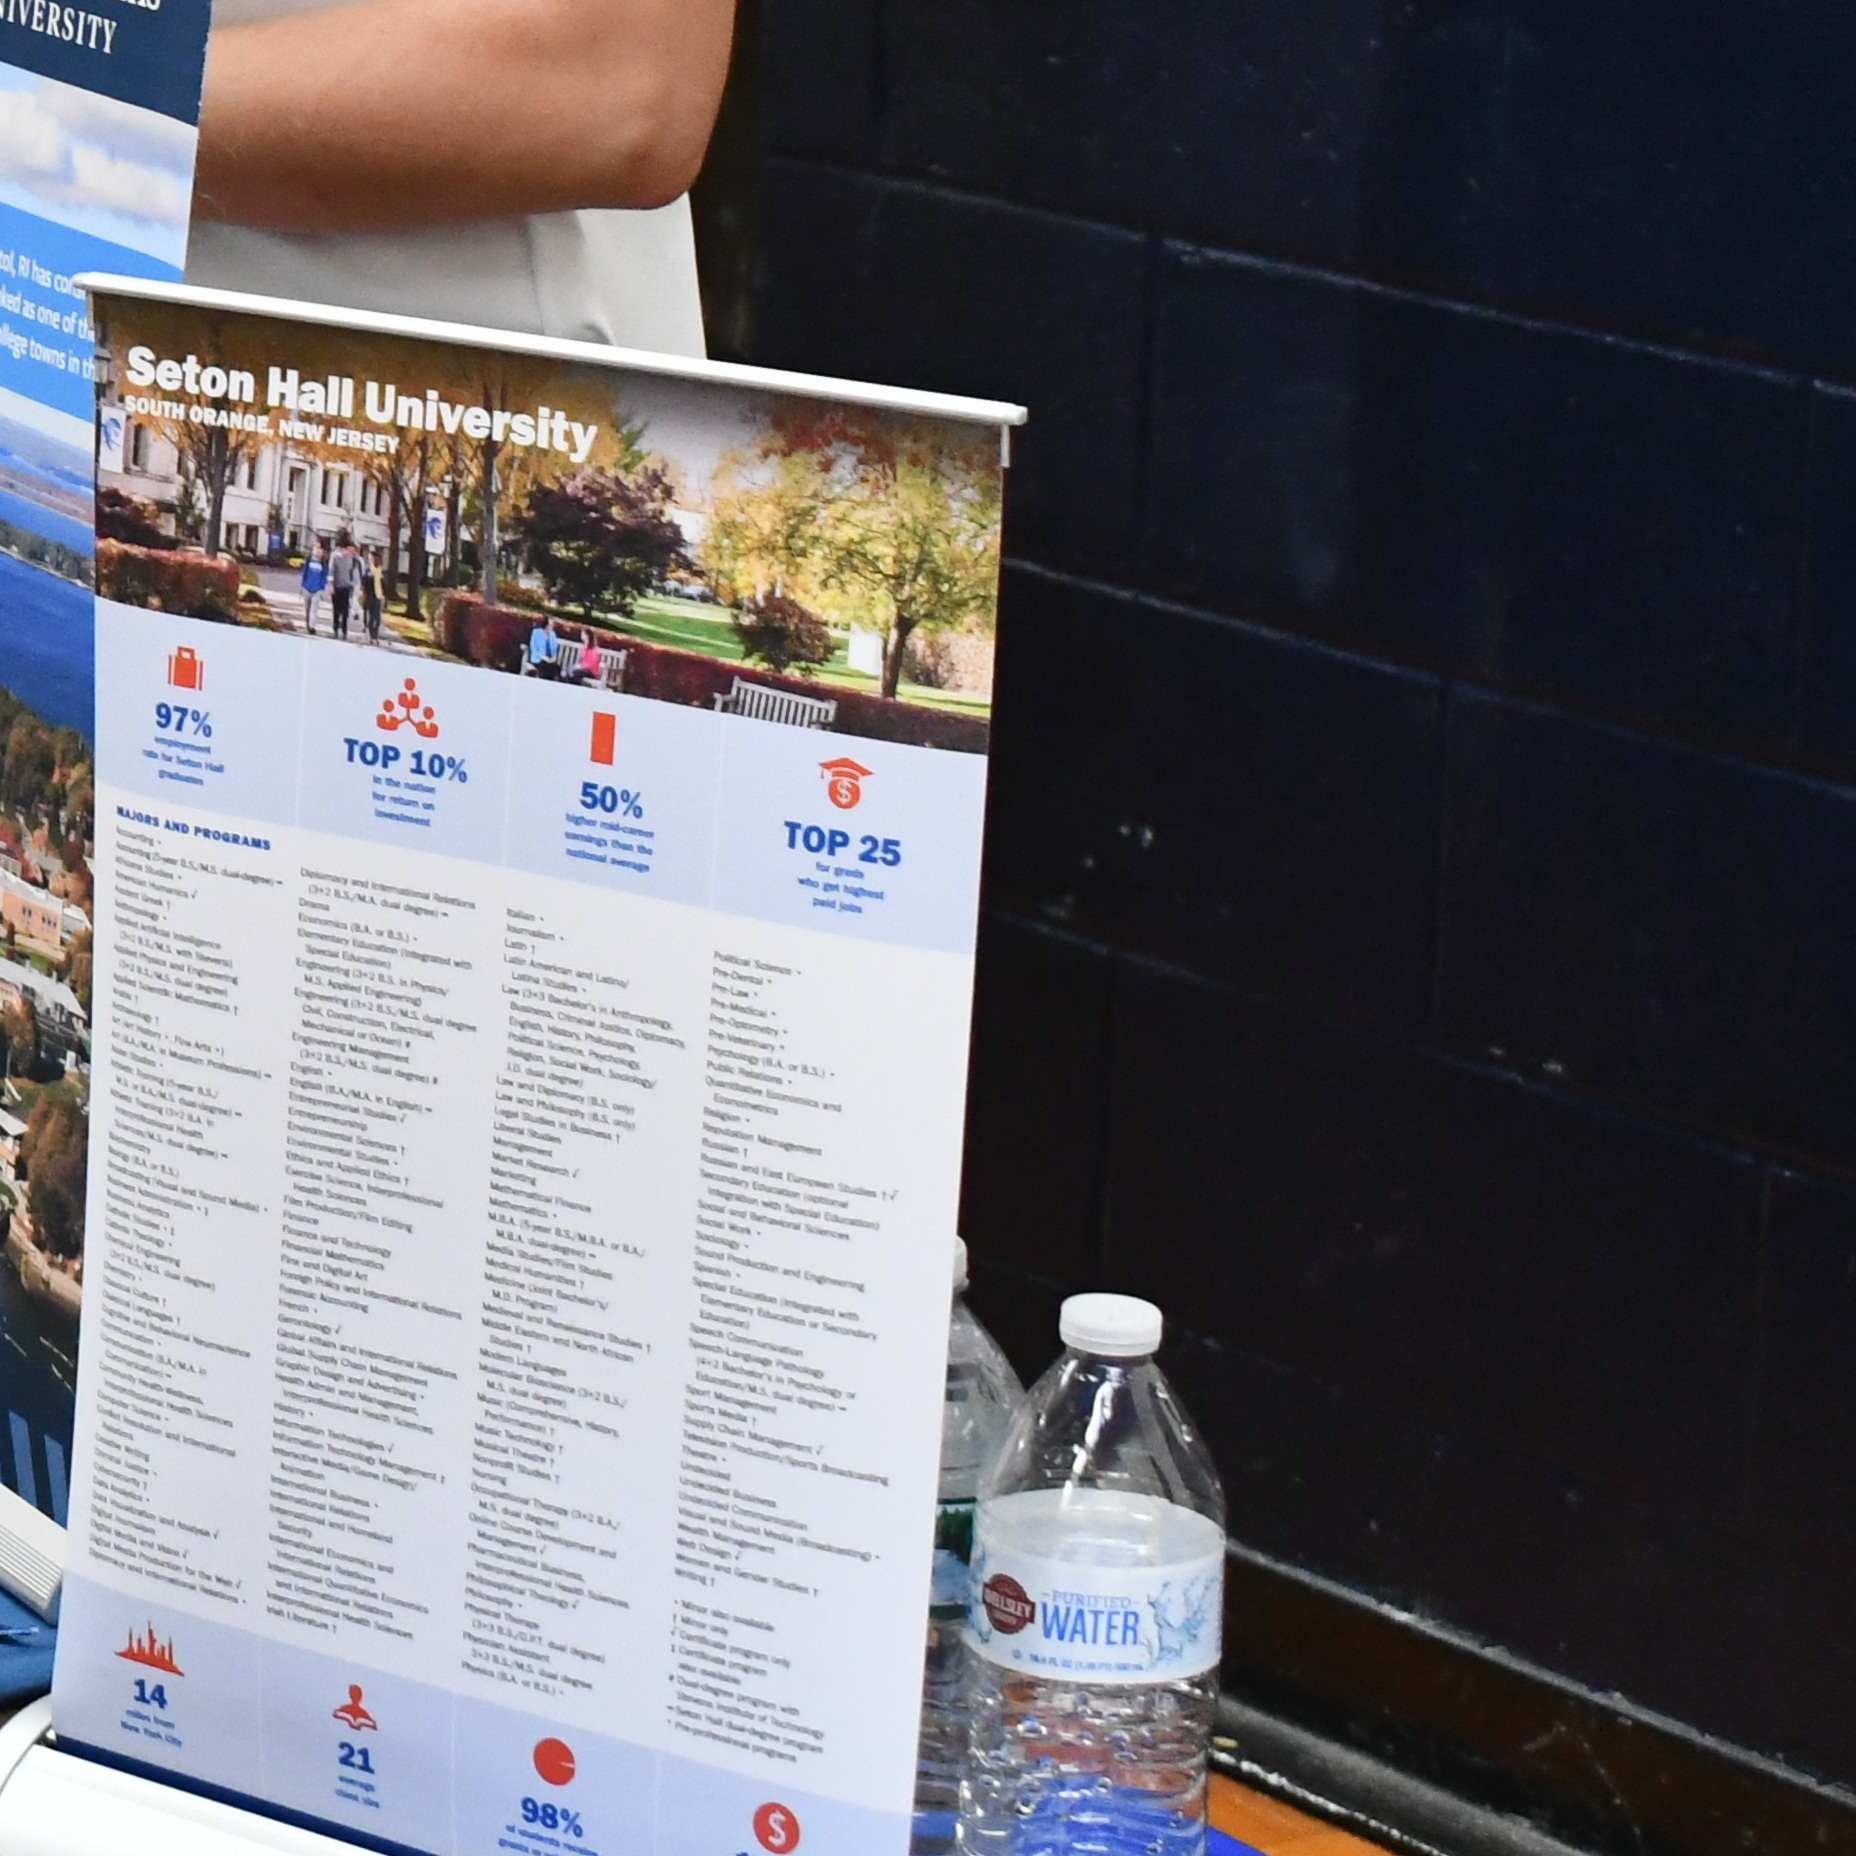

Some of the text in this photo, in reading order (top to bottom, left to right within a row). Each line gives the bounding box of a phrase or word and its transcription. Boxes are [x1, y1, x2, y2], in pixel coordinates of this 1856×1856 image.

[19, 255, 30, 278] RI
[32, 259, 52, 288] has
[22, 299, 35, 319] as
[38, 304, 60, 329] one
[62, 312, 78, 333] of
[30, 337, 66, 369] towns
[68, 350, 80, 374] in
[126, 345, 597, 463] Seton Hall University
[124, 395, 400, 455] SOUTH ORANGE, NEW JERSEY
[156, 702, 212, 738] 97%
[343, 737, 467, 783] TOP 10%
[373, 791, 386, 801] for
[390, 796, 419, 808] return
[385, 778, 401, 788] the
[404, 782, 436, 794] nation
[579, 781, 643, 819] 50%
[116, 805, 272, 851] MAJORS AND PROGRAMS
[375, 808, 430, 827] investment
[566, 813, 654, 839] higher mid-career
[611, 840, 634, 851] than
[637, 844, 653, 856] the
[784, 820, 901, 866] TOP 25
[1052, 1590, 1132, 1609] PURIFIED
[1042, 1602, 1140, 1645] WATER
[133, 1678, 168, 1709] 14
[338, 1741, 375, 1775] 21
[521, 1797, 583, 1838] 98%
